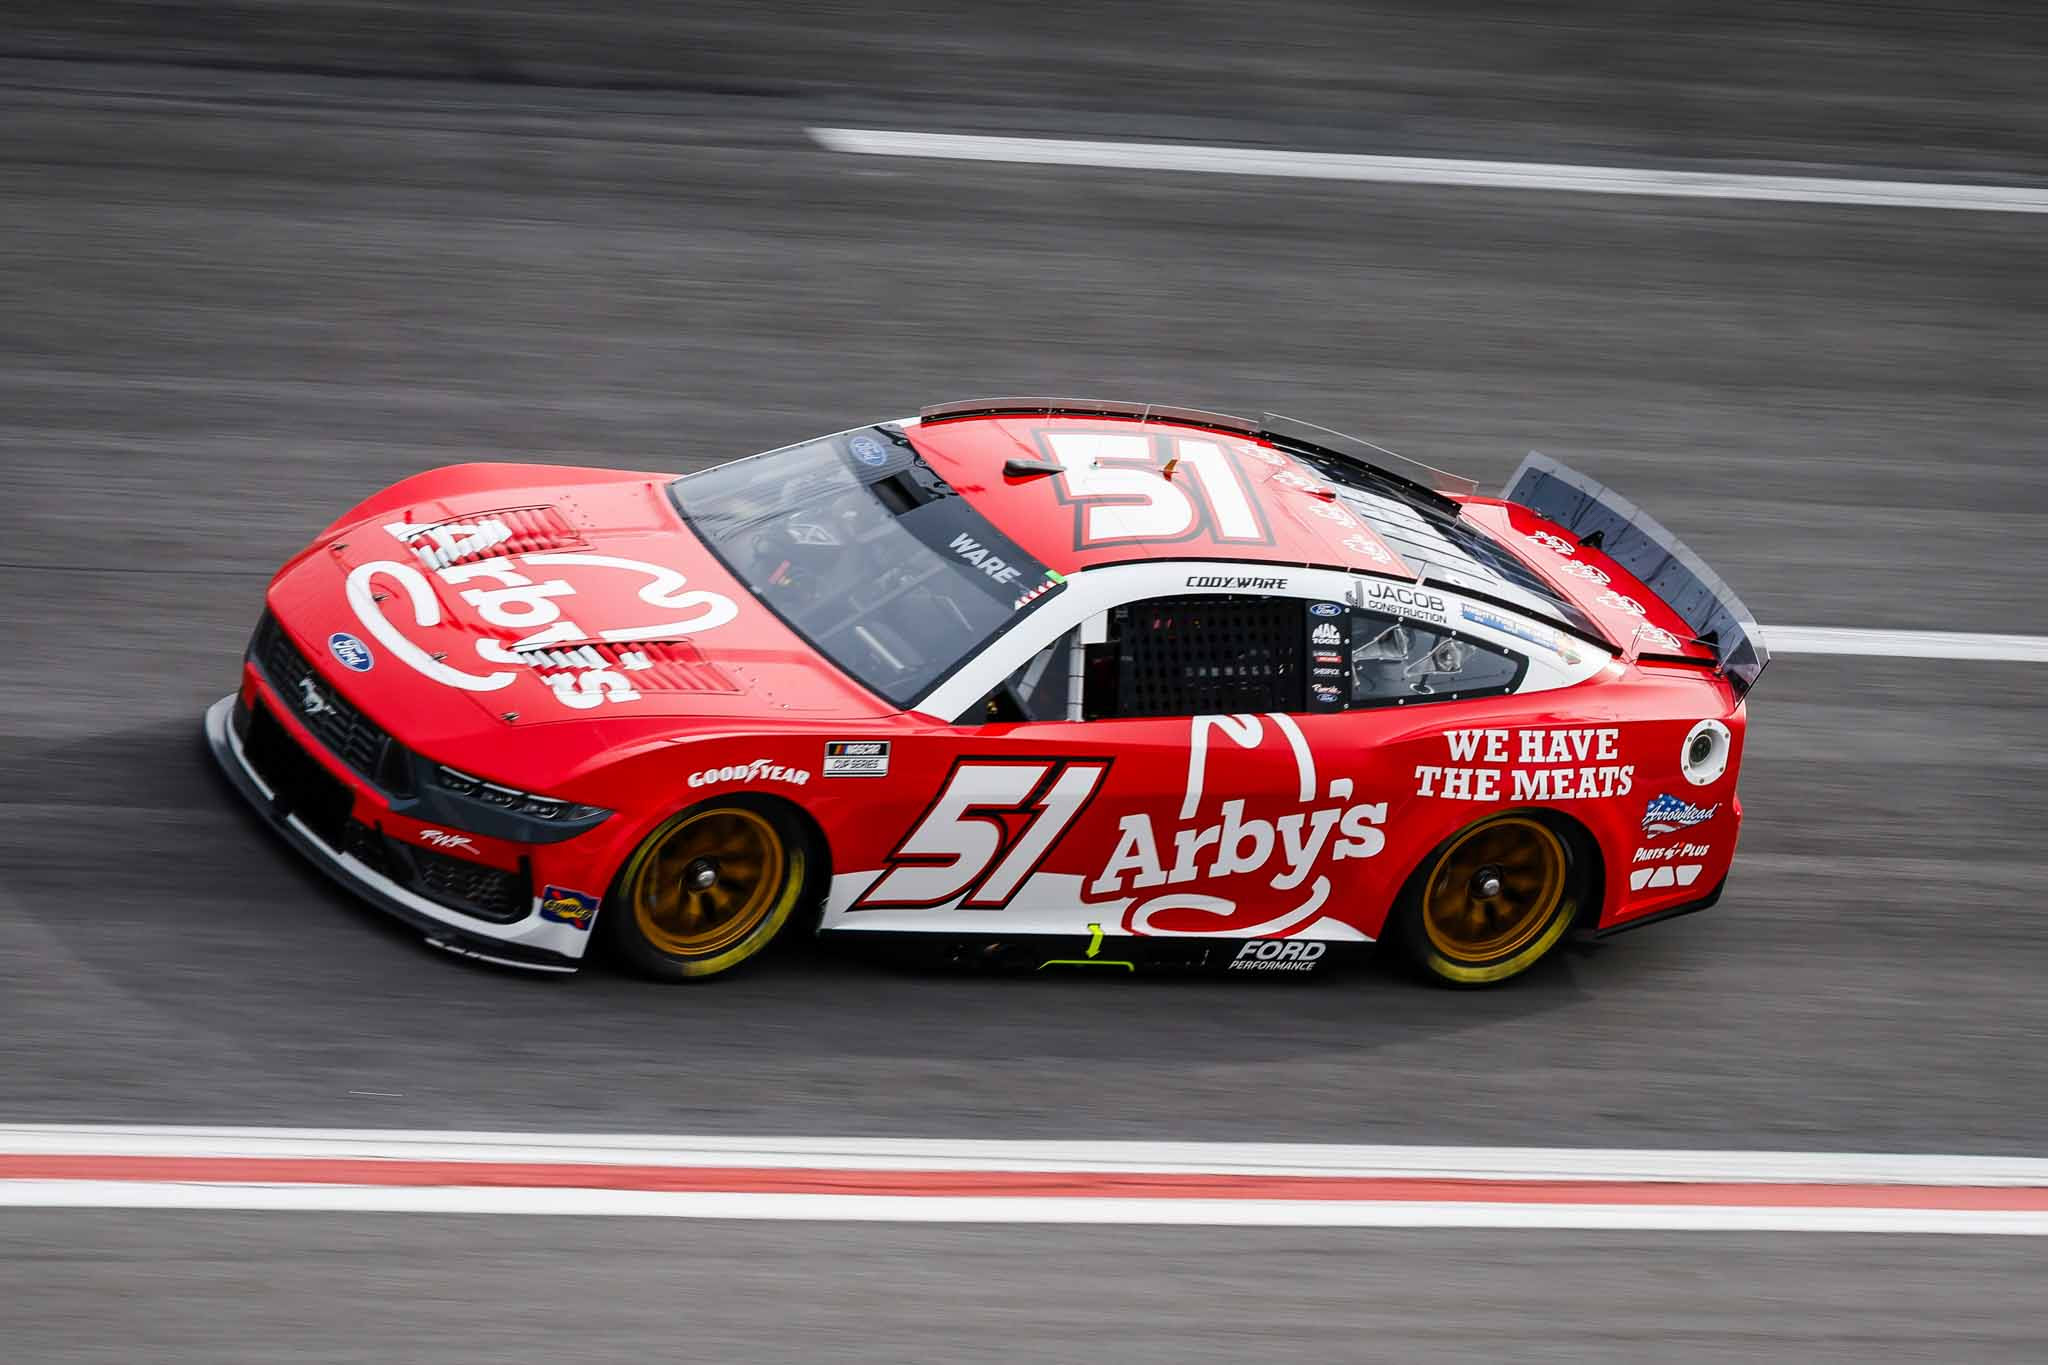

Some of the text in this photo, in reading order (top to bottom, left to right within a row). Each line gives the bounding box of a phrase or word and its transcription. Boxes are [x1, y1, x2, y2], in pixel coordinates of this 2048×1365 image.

[1038, 431, 1272, 547] 51
[950, 532, 1022, 584] WARE
[1186, 576, 1288, 590] CODY WARE
[1368, 584, 1445, 611] JACOB
[1368, 600, 1447, 623] CONSTRUCTION
[1312, 624, 1340, 639] MAC
[332, 638, 369, 666] Ford
[846, 744, 881, 755] NASCAR
[1443, 728, 1619, 763] WE HAVE
[687, 758, 810, 788] GOODYEAR
[833, 759, 880, 768] CUP SERIES
[1414, 765, 1635, 801] THE MEATS
[849, 757, 1113, 910] 51
[1091, 778, 1388, 894] Arby's
[1235, 940, 1326, 961] FORD
[1229, 960, 1316, 971] PERFORMANCE
